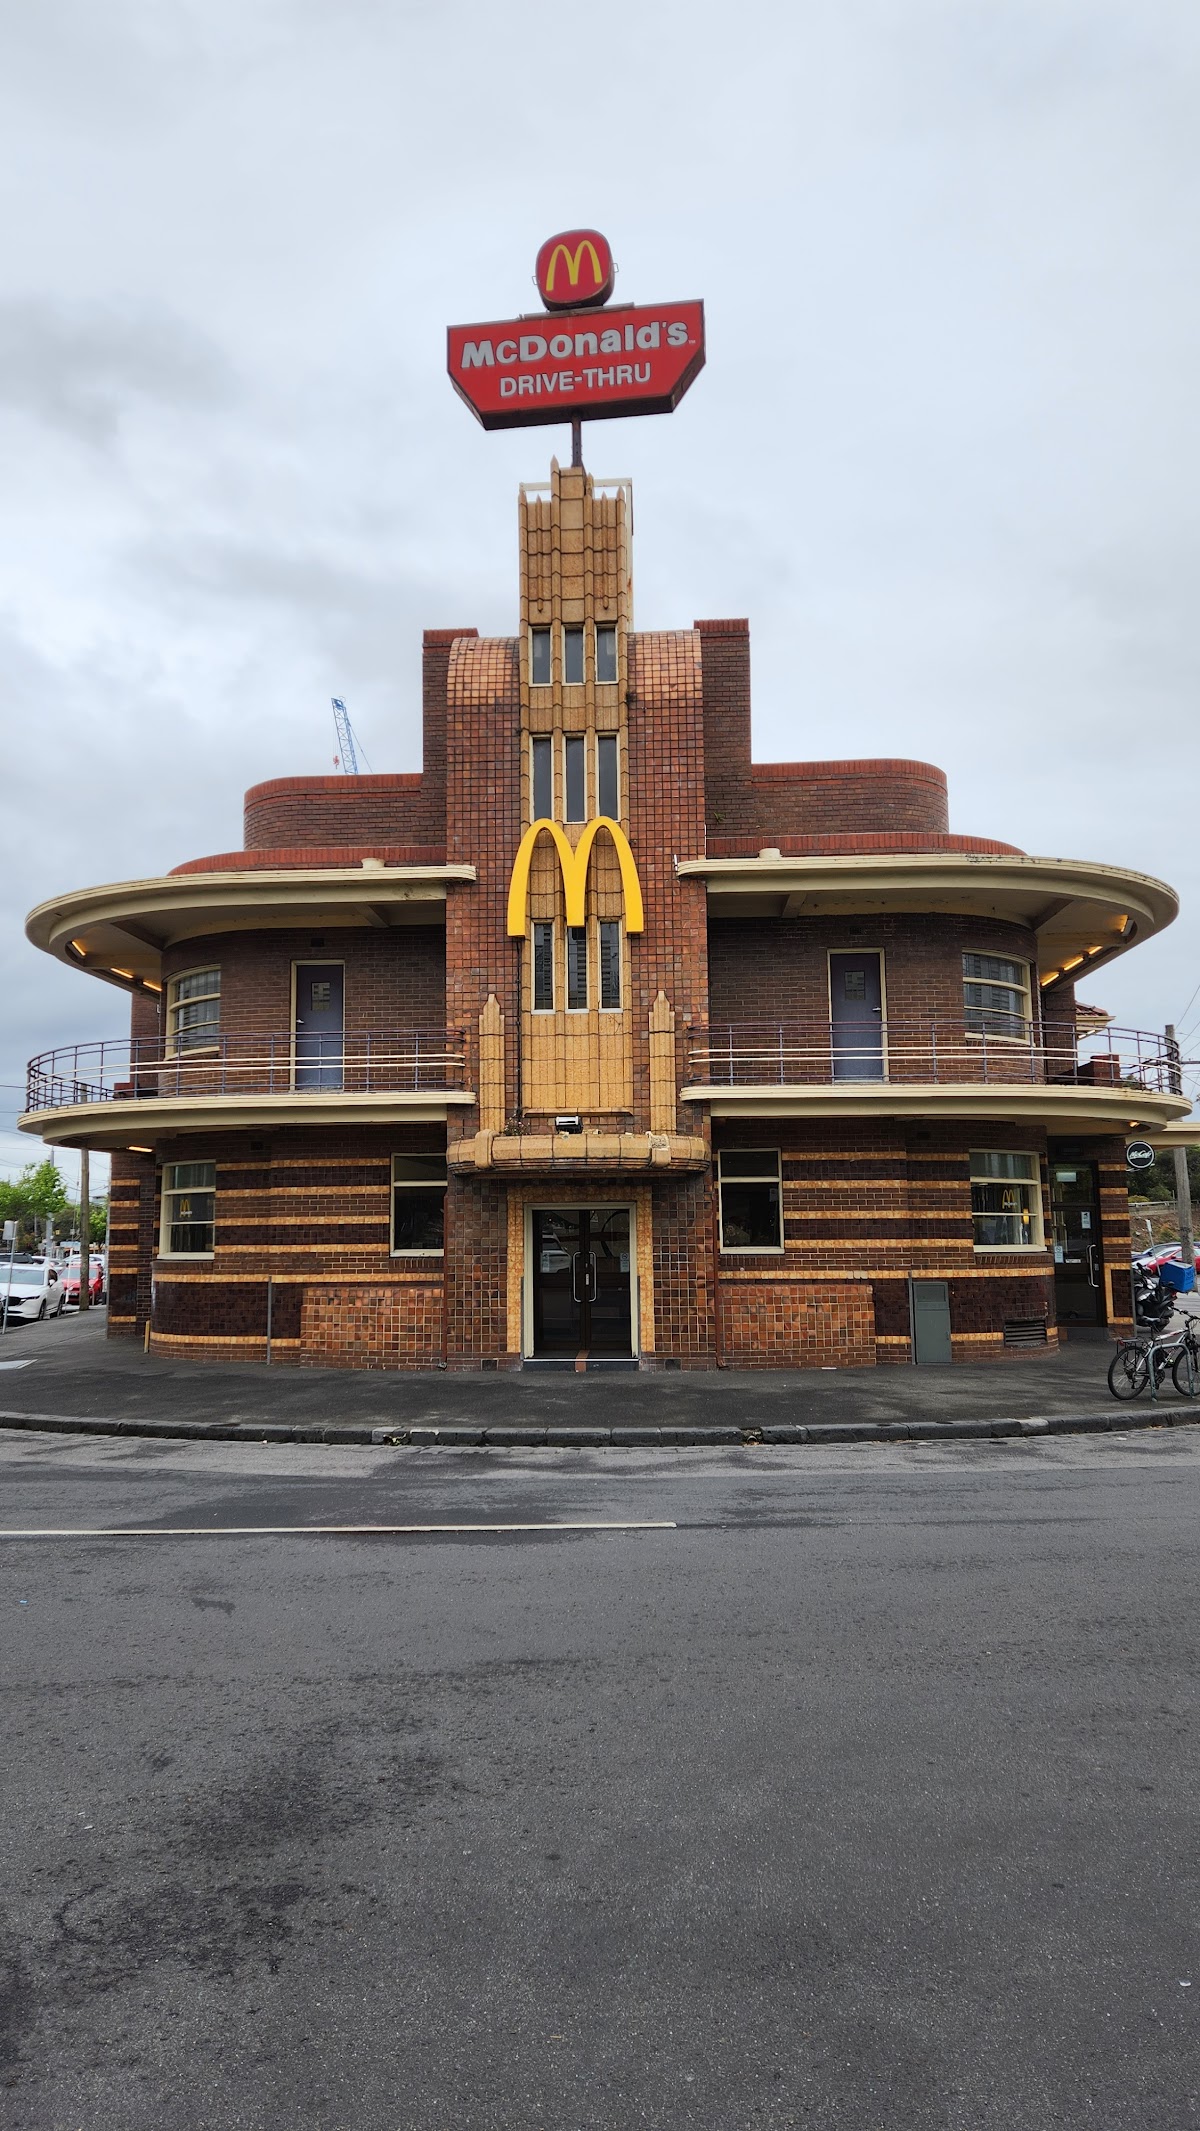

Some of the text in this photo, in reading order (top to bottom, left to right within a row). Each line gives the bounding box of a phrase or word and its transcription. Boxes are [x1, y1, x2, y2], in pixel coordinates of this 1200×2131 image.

[546, 239, 603, 291] M
[461, 321, 689, 368] McDonald's
[500, 362, 651, 397] DRIVE-THRU
[507, 816, 644, 937] M
